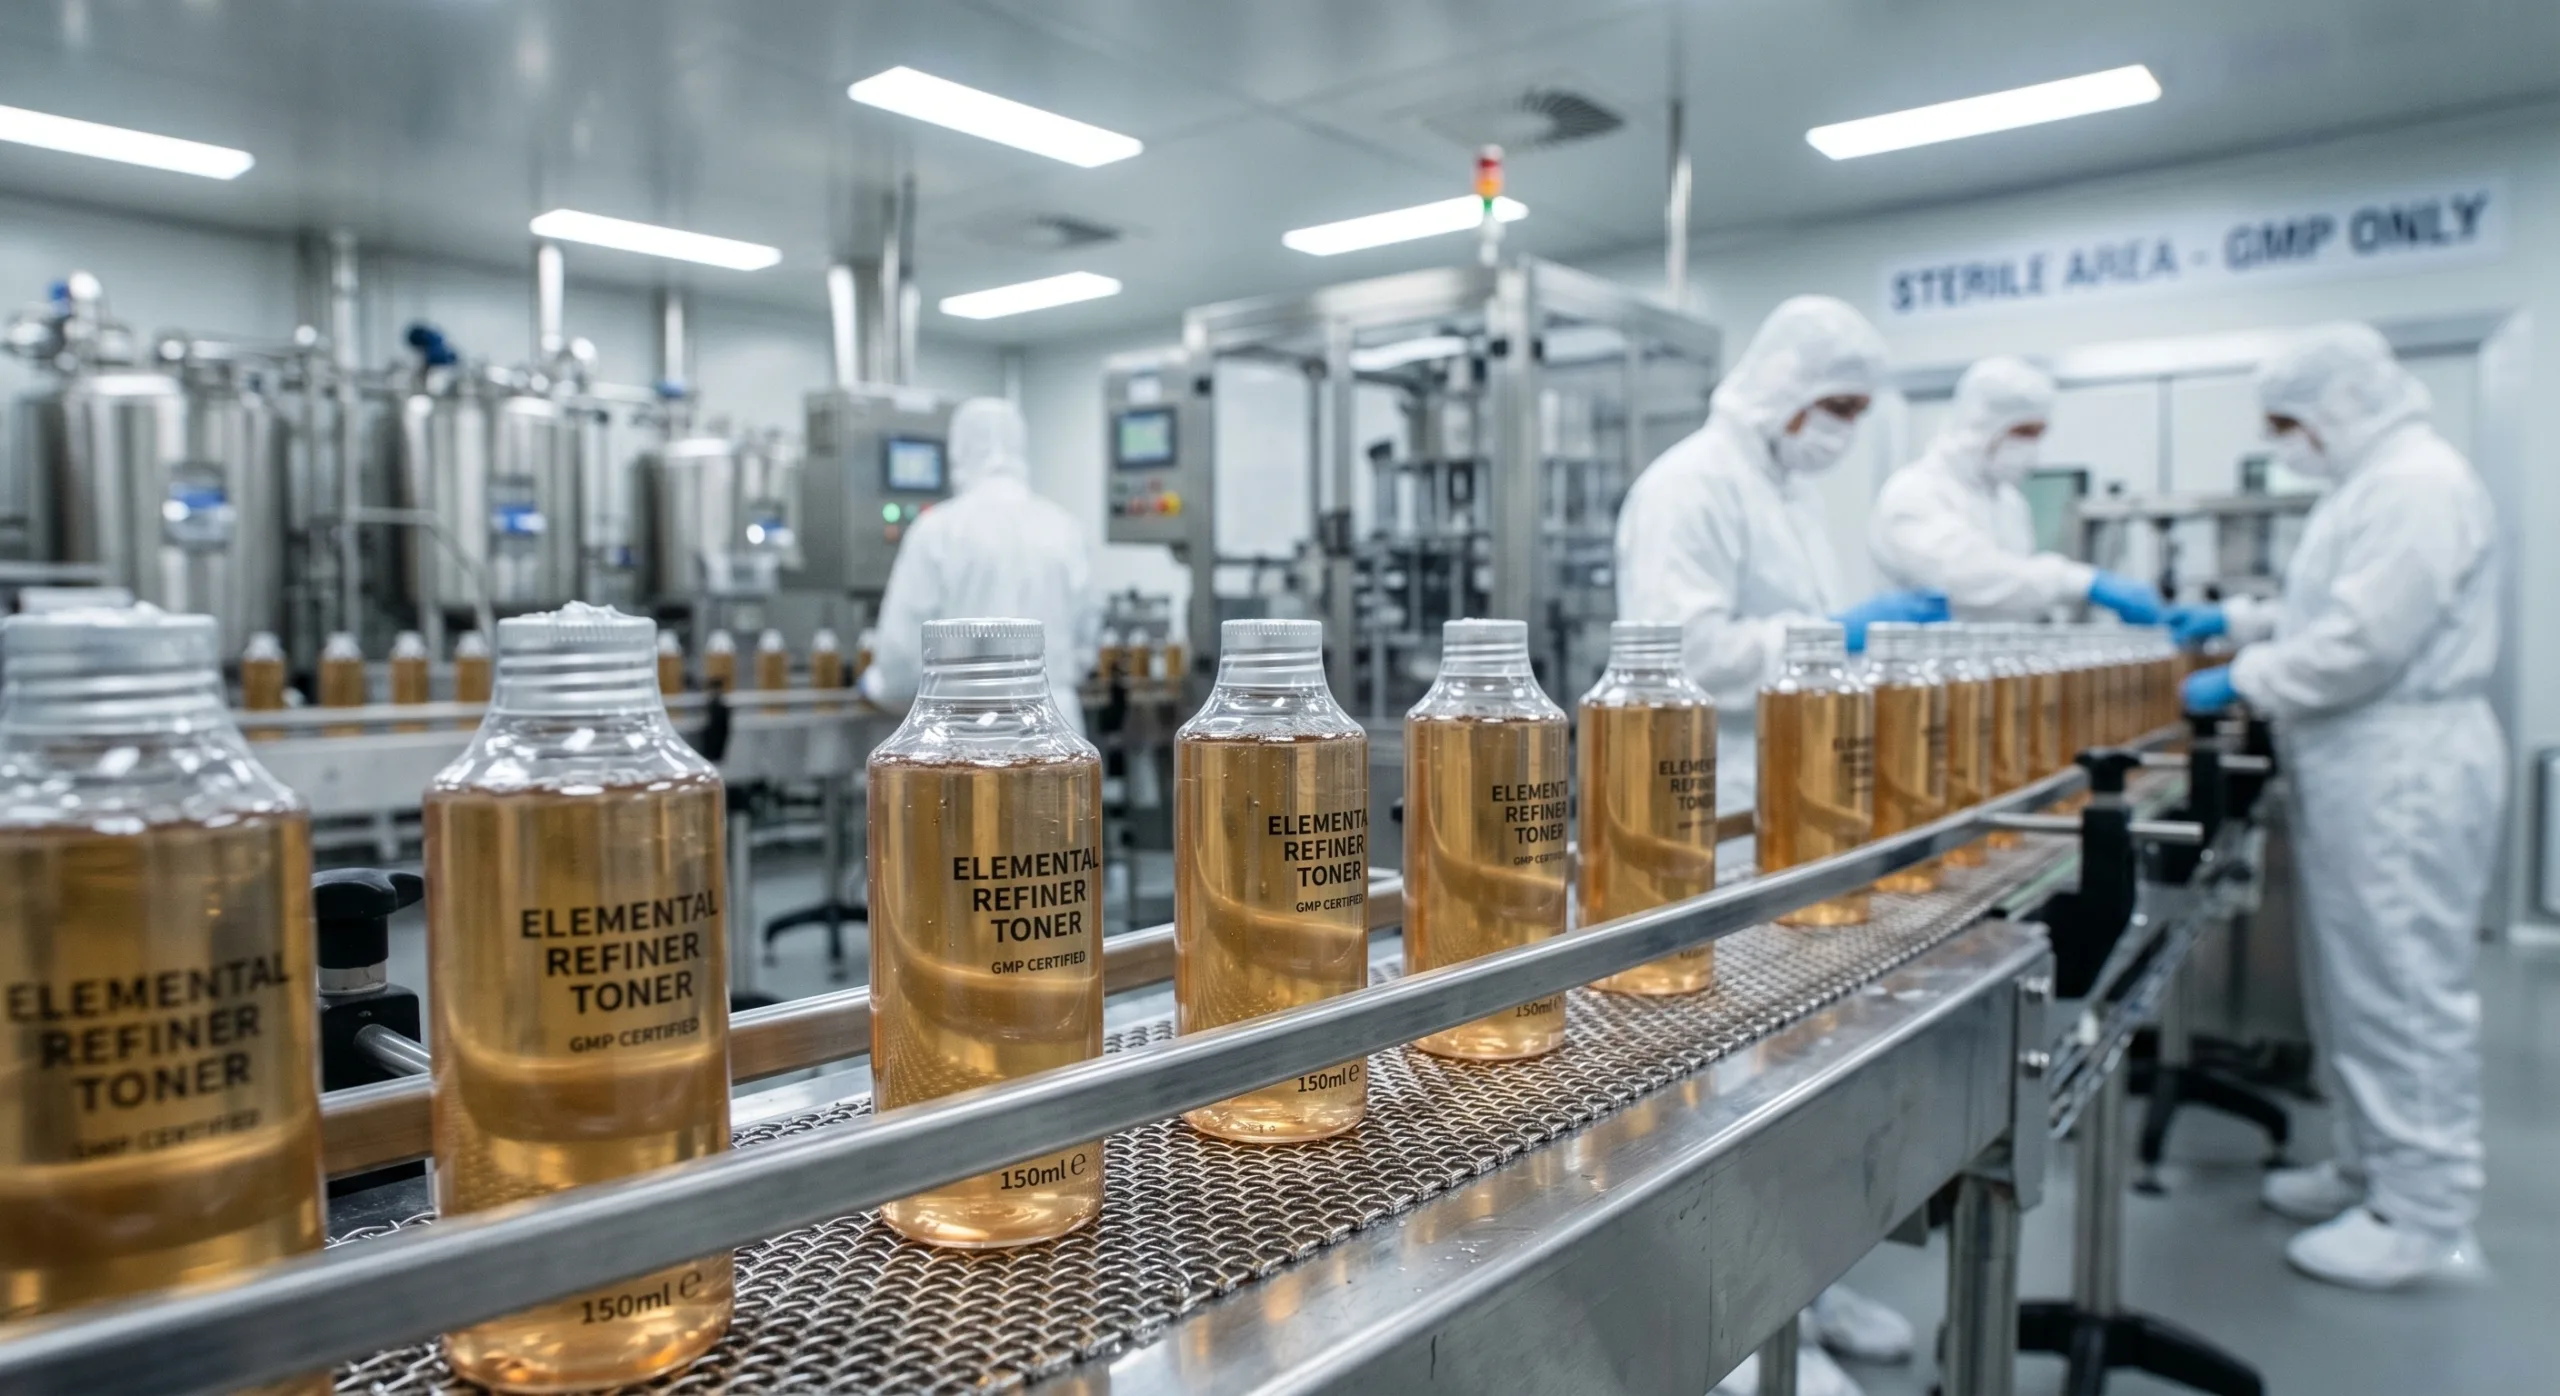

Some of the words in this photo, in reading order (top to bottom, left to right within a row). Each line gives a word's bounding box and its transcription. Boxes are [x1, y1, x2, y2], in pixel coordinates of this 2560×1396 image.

[1891, 252, 2048, 313] STERILE
[2063, 238, 2180, 287] AREA
[2224, 213, 2337, 271] GMP
[2348, 188, 2490, 257] ONLY
[1284, 834, 1364, 862] REFINER
[1514, 823, 1564, 844] TONER
[953, 846, 1099, 880] ELEMENTAL
[1297, 861, 1361, 887] TONER
[973, 879, 1086, 912] REFINER
[1296, 901, 1321, 913] GMP
[521, 890, 718, 939] ELEMENTAL
[991, 911, 1082, 942] TONER
[546, 932, 700, 976] REFINER
[991, 960, 1024, 974] GMP
[1028, 951, 1085, 971] CERTIFIED
[6, 953, 289, 1022] ELEMENTAL
[569, 971, 693, 1014] TONER
[40, 1004, 260, 1068] REFINER
[570, 1033, 614, 1053] GMP
[619, 1017, 699, 1047] CERTIFIED
[75, 1052, 251, 1112] TONER
[1298, 1068, 1346, 1092] 150ml
[1001, 1159, 1066, 1190] 150ml
[581, 1282, 672, 1324] 150ml
